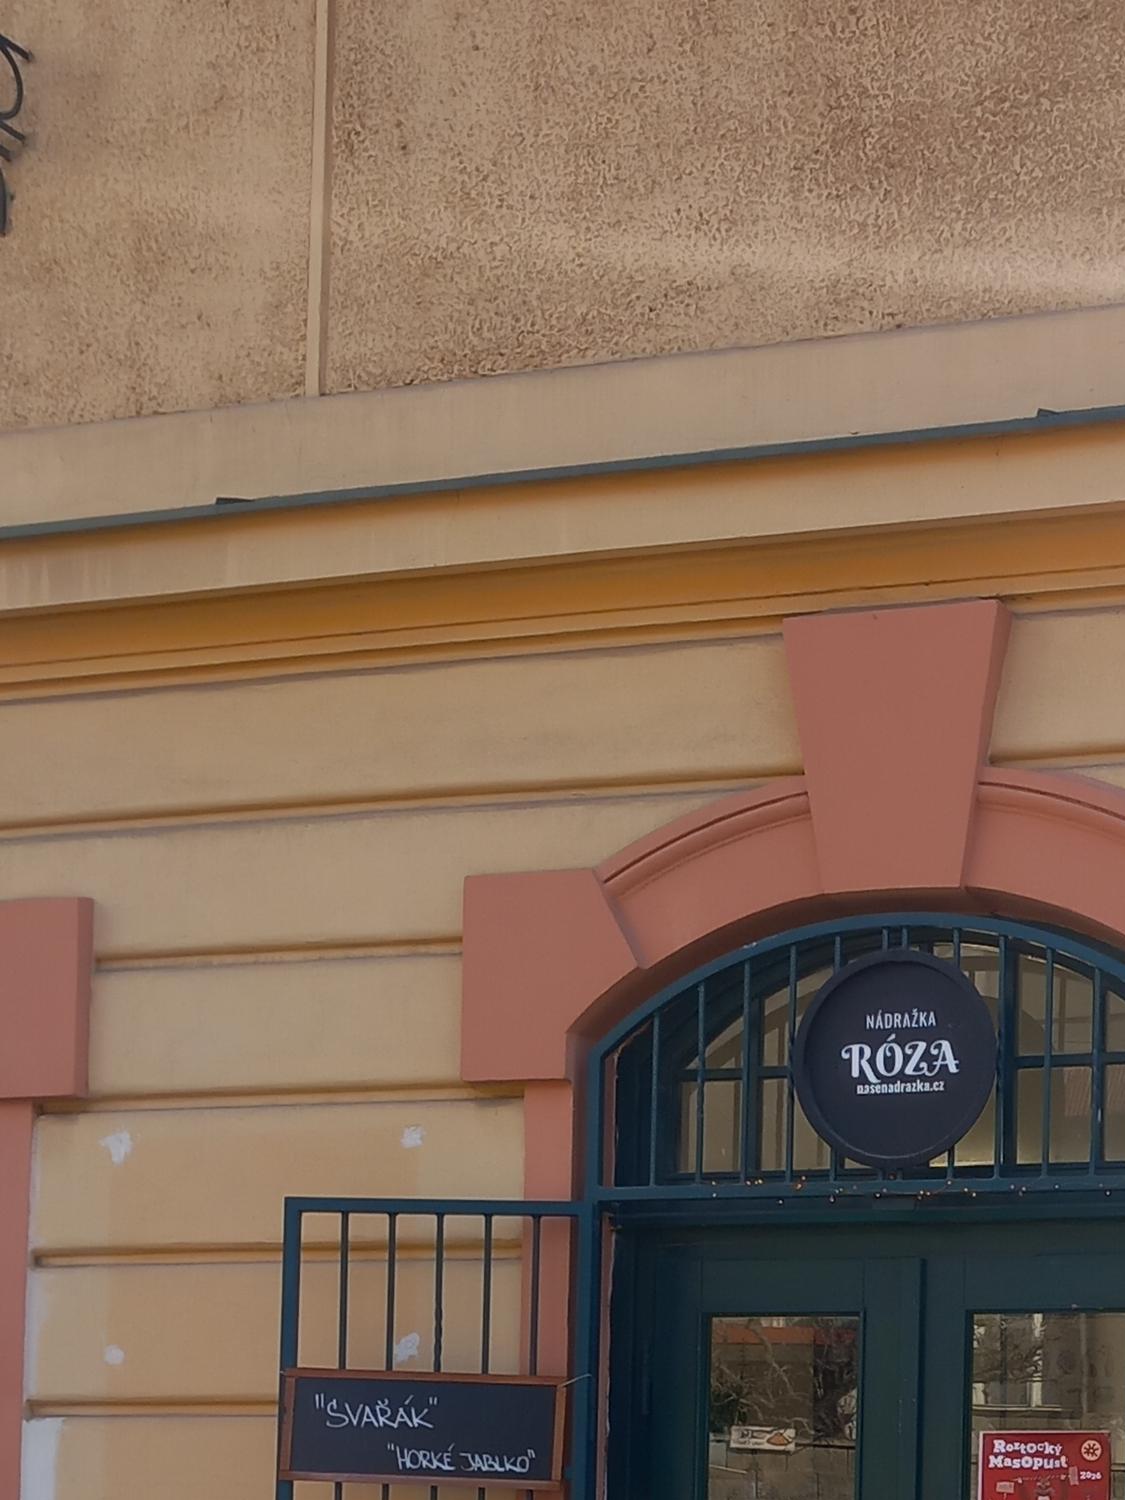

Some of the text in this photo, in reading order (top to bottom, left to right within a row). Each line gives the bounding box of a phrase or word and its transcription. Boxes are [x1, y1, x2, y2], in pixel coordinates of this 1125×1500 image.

[866, 1008, 936, 1030] NÁDRAŽKA
[841, 1033, 960, 1083] RÓZA
[856, 1079, 945, 1095] nasenadrazka.cz
[993, 1439, 1062, 1456] Roztocký
[1080, 1471, 1101, 1480] 2026
